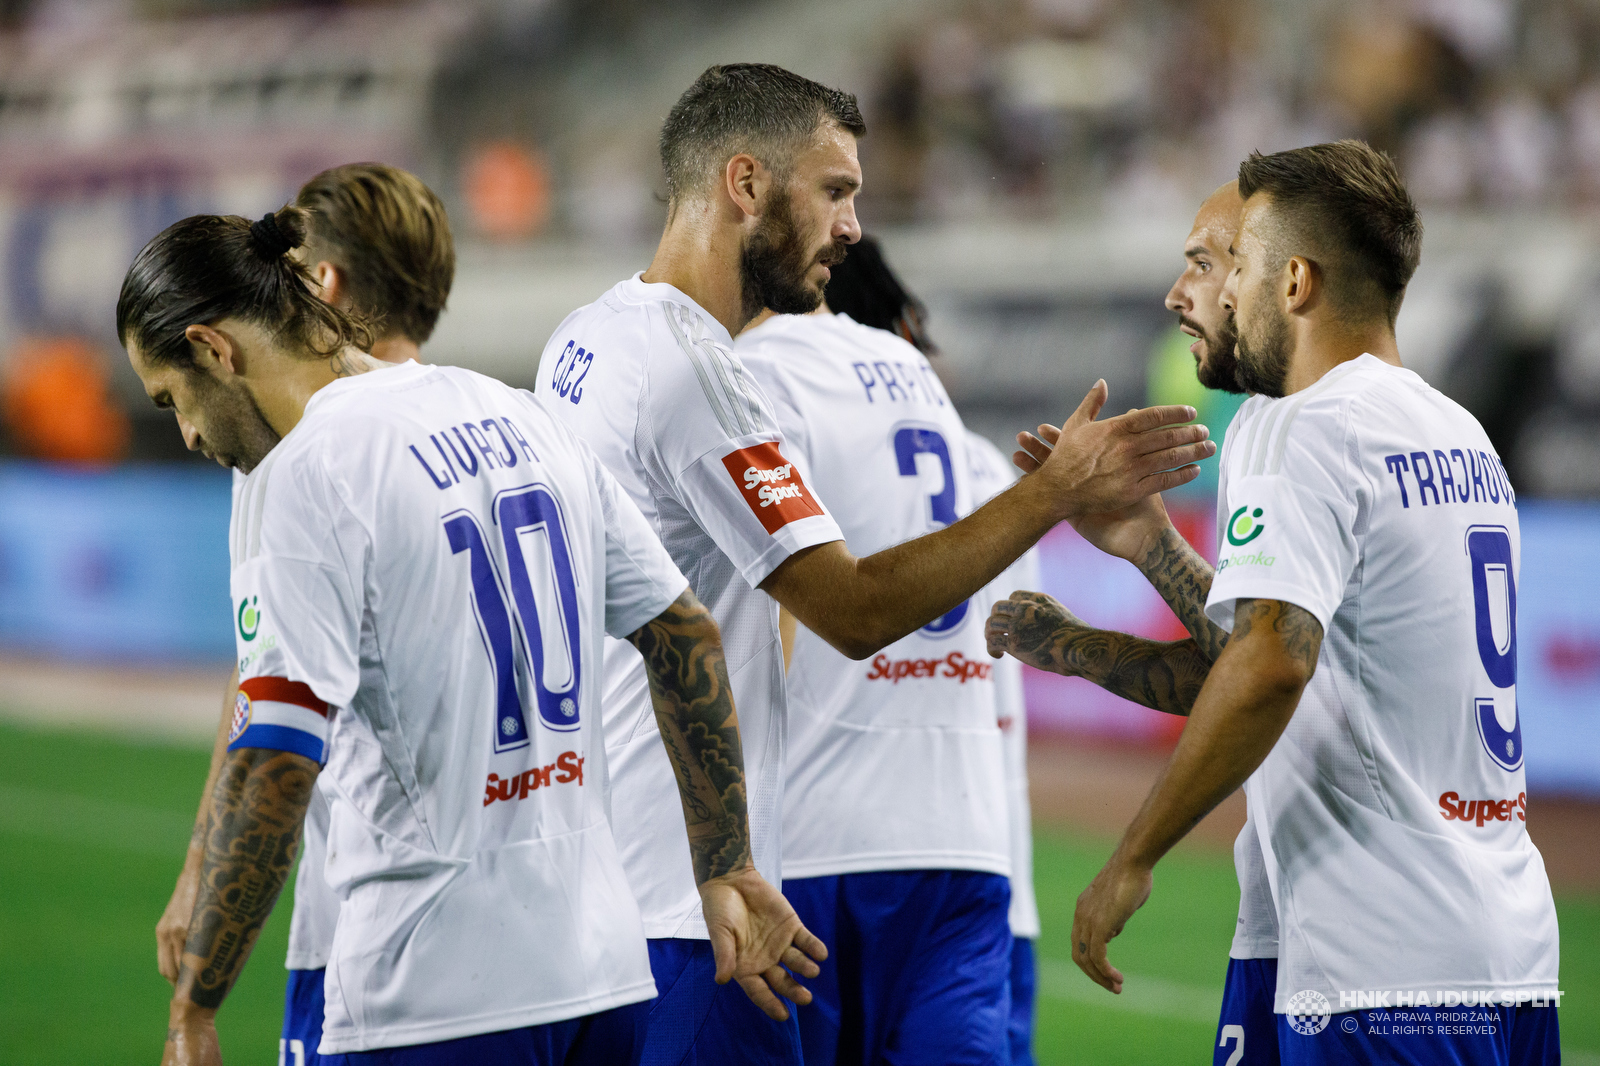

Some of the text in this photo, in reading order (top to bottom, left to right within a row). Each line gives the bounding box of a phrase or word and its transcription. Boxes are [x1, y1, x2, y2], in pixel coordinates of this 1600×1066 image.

[552, 339, 594, 405] ELEZ
[408, 417, 541, 490] LIVAJA
[743, 463, 792, 490] Super
[757, 482, 803, 508] Sport
[889, 422, 972, 640] 3
[440, 482, 580, 754] 10
[1464, 524, 1524, 773] 9
